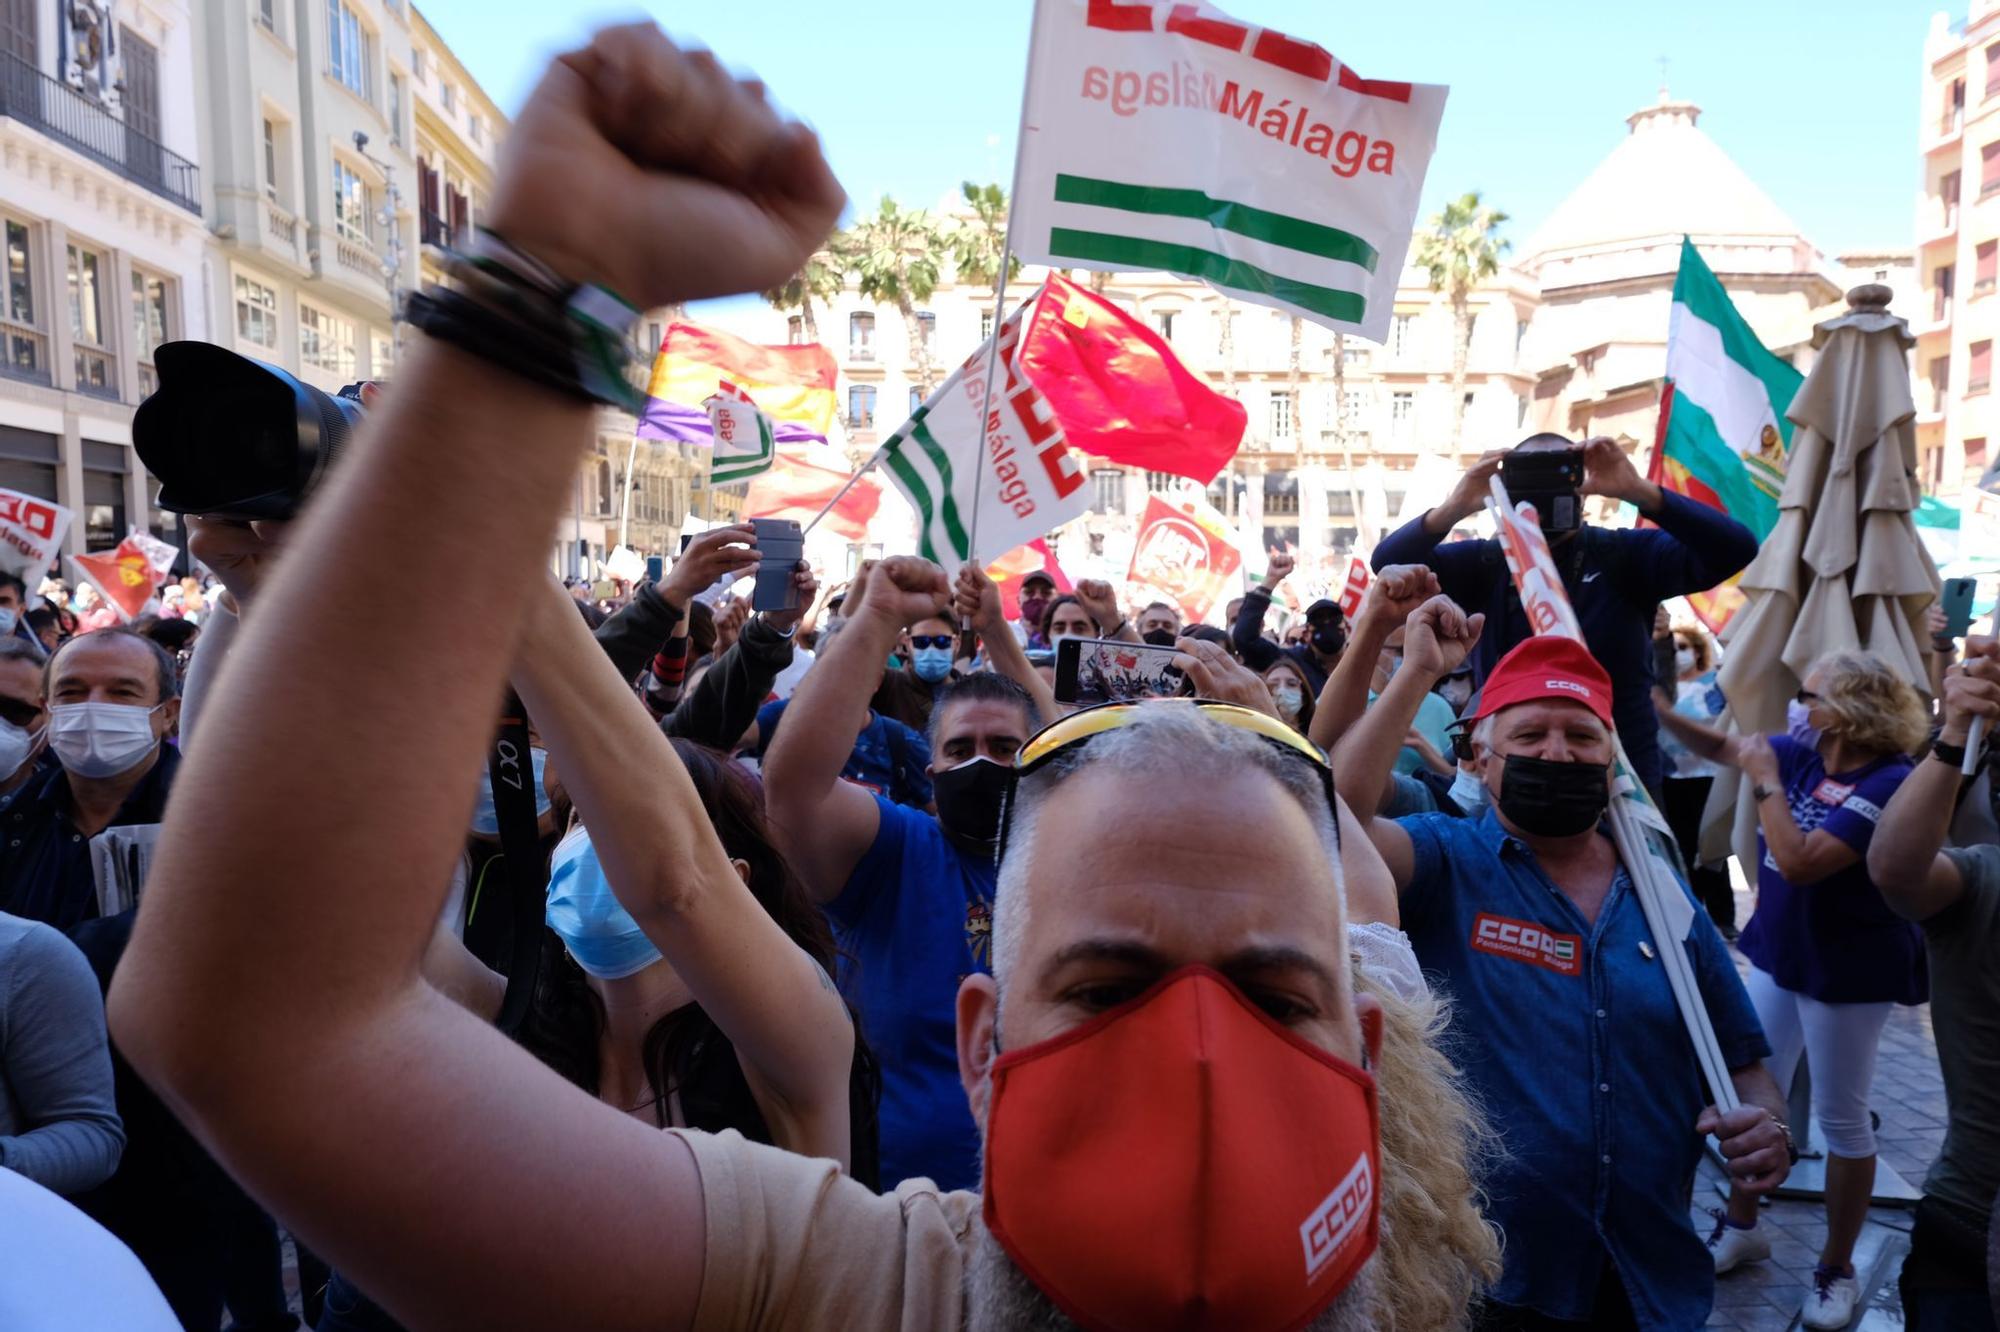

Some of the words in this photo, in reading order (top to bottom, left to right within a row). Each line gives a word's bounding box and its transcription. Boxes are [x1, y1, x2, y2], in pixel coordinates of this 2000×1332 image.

[1219, 80, 1396, 179] Málaga
[718, 408, 736, 446] aga
[0, 525, 44, 561] laga
[1479, 918, 1554, 955] CCOO
[1308, 1168, 1370, 1258] CCOO
